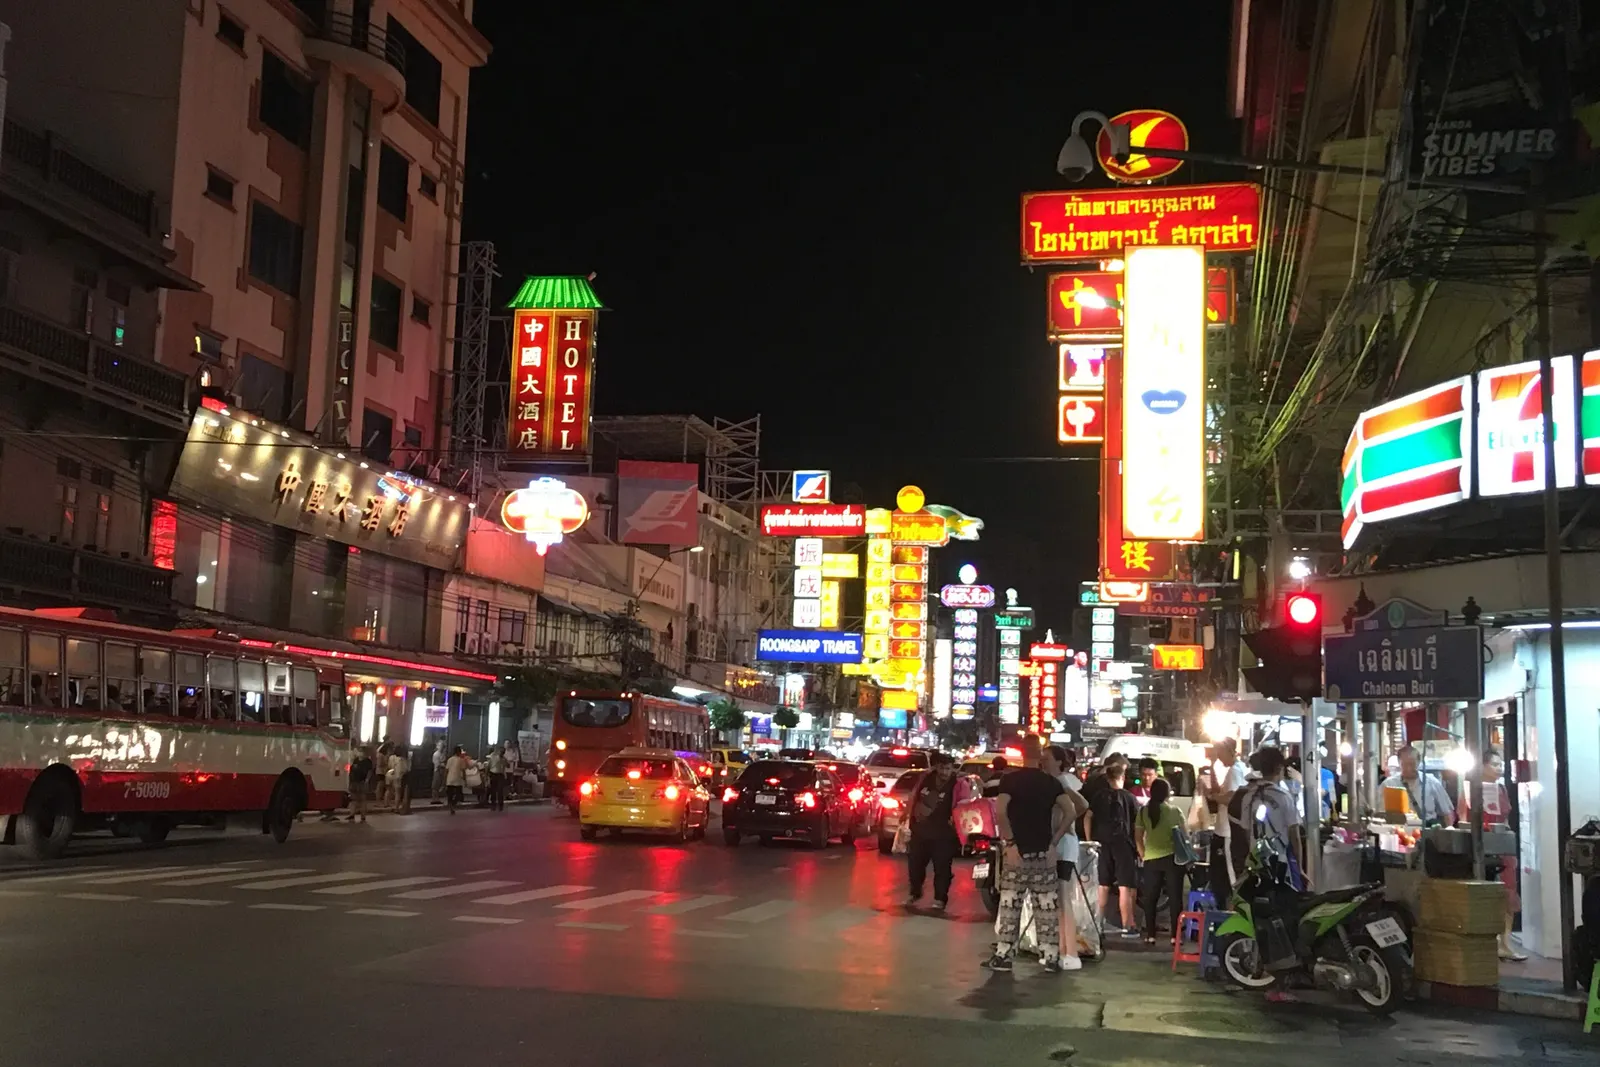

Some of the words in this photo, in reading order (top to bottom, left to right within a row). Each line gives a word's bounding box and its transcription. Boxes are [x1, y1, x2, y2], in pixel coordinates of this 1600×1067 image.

[1423, 129, 1557, 157] SUMMER
[1423, 155, 1496, 176] VIBES
[516, 317, 545, 450] 中國大酒店
[560, 319, 583, 452] HOTEL
[1139, 604, 1198, 616] SEAFOOD
[822, 639, 860, 655] TRAVEL
[1358, 637, 1438, 680] เฉลิมบุรี
[1362, 681, 1407, 697] Chaloem
[1411, 681, 1435, 696] Buri
[123, 781, 171, 799] 7-50309
